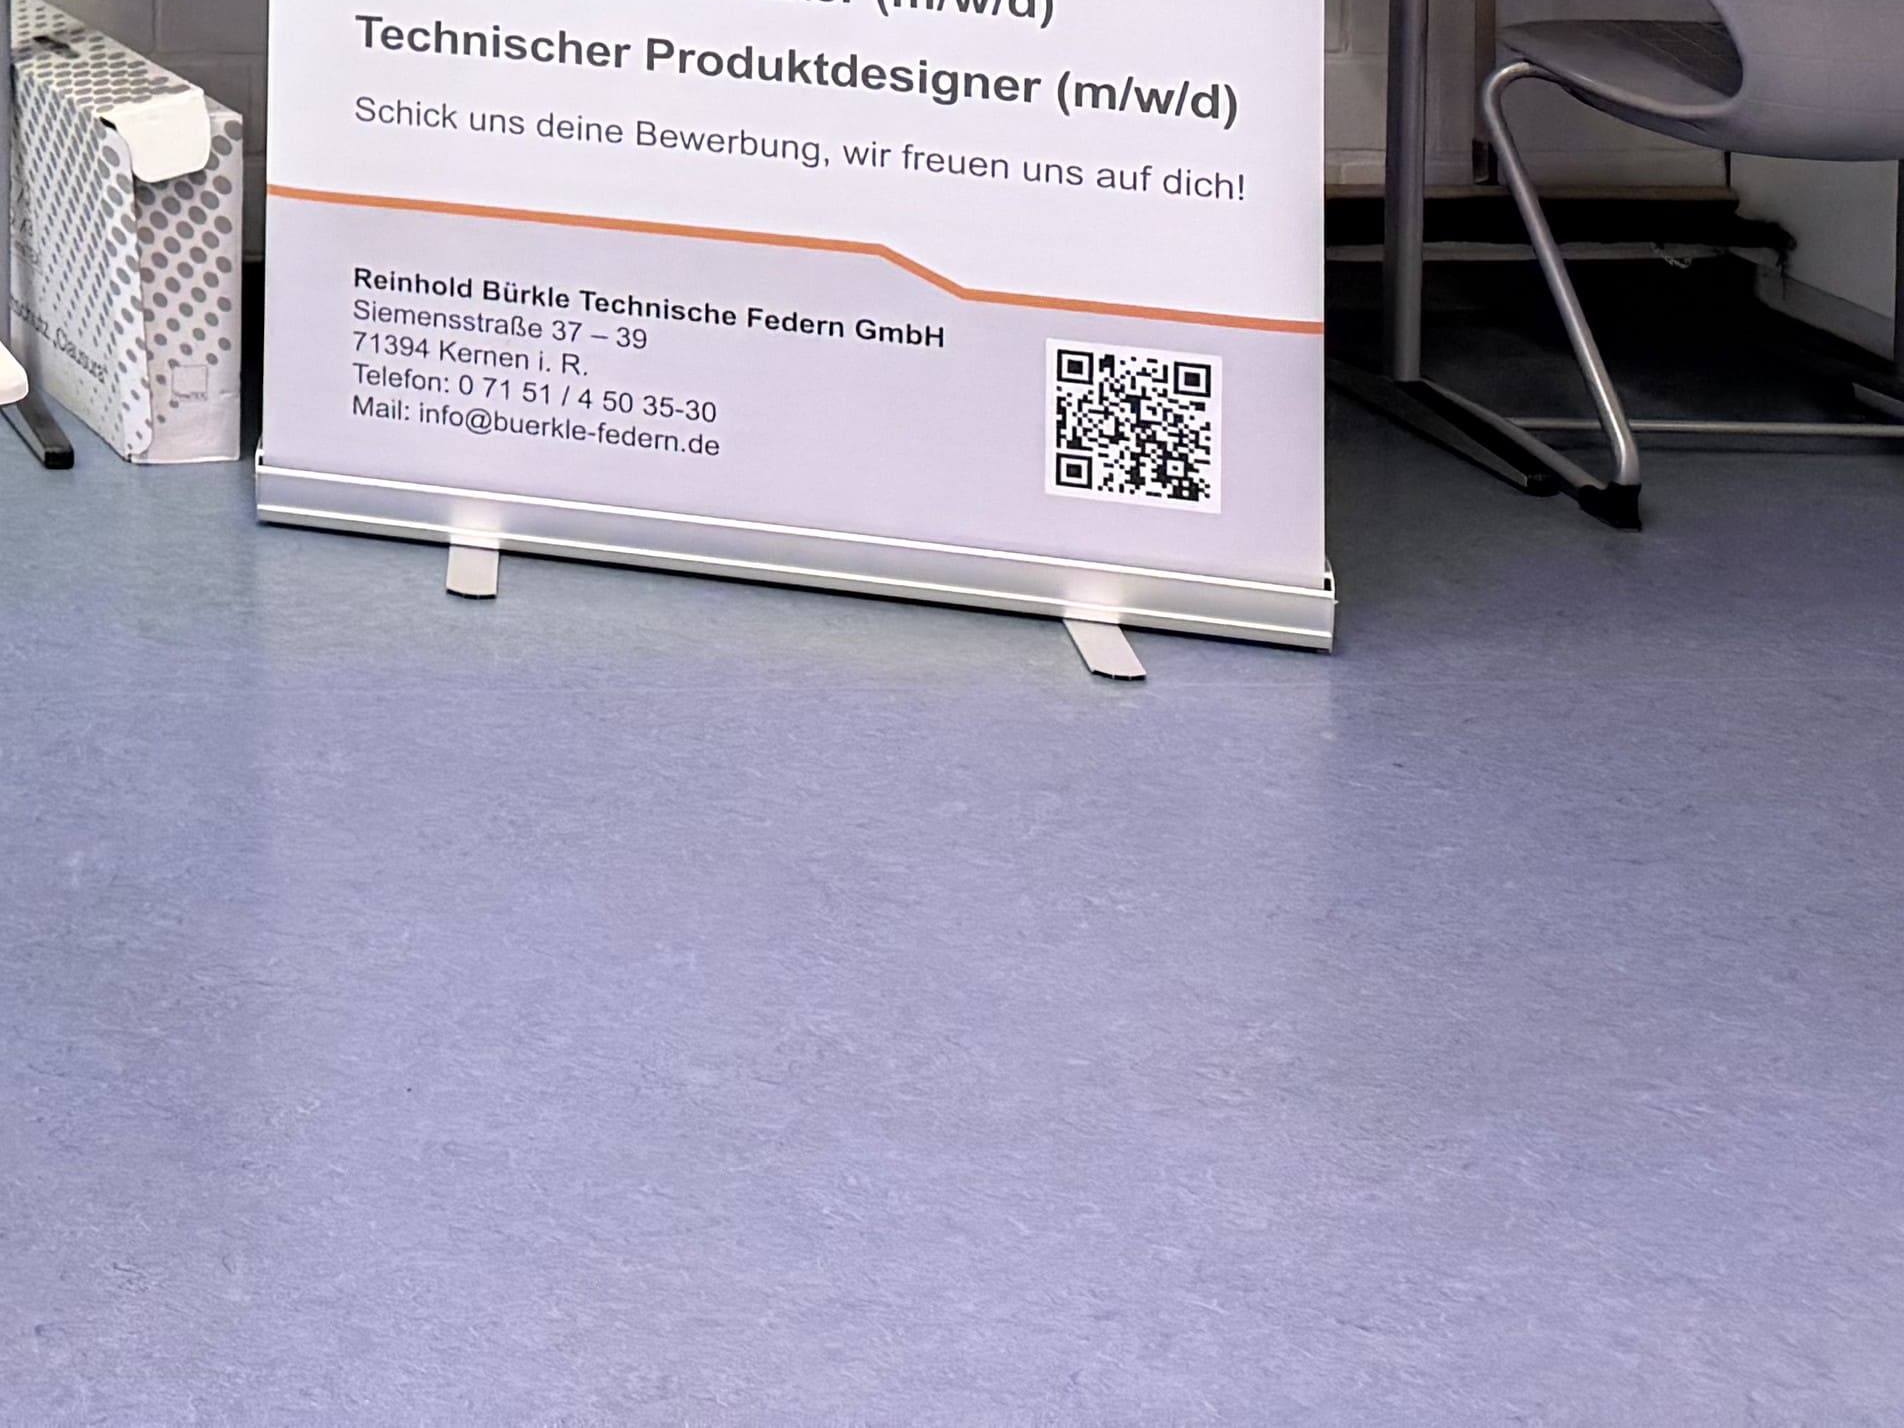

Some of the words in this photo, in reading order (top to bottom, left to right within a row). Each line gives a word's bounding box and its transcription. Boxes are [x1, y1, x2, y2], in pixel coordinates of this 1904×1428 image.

[355, 15, 631, 68] Technischer
[647, 38, 1041, 105] Produktdesigner
[1058, 71, 1237, 130] (m/w/d)
[356, 97, 457, 129] Schick
[470, 112, 524, 134] uns
[537, 113, 623, 143] deine
[637, 121, 829, 168] Bewerbung,
[843, 141, 891, 167] wir
[902, 144, 1008, 179] freuen
[1024, 162, 1083, 185] uns
[1097, 165, 1152, 191] auf
[1163, 168, 1243, 200] dich!
[354, 300, 542, 339] Siemensstraße
[553, 320, 582, 342] 37
[617, 327, 646, 349] 39
[355, 268, 472, 300] Reinhold
[484, 280, 569, 308] Bürkle
[580, 290, 736, 325] Technische
[748, 308, 843, 337] Federn
[856, 319, 943, 347] GmbH
[354, 331, 429, 358] 71394
[440, 340, 528, 370] Kernen
[539, 351, 550, 372] i.
[562, 353, 587, 376] R.
[353, 363, 448, 393] Telefon:
[459, 375, 473, 395] 0
[483, 377, 509, 400] 71
[523, 382, 548, 404] 51
[578, 389, 592, 409] 4
[603, 391, 633, 413] 50
[644, 395, 716, 422] 35-30
[353, 395, 409, 420] Mail:
[420, 401, 720, 457] info@buerkle-federn.de
